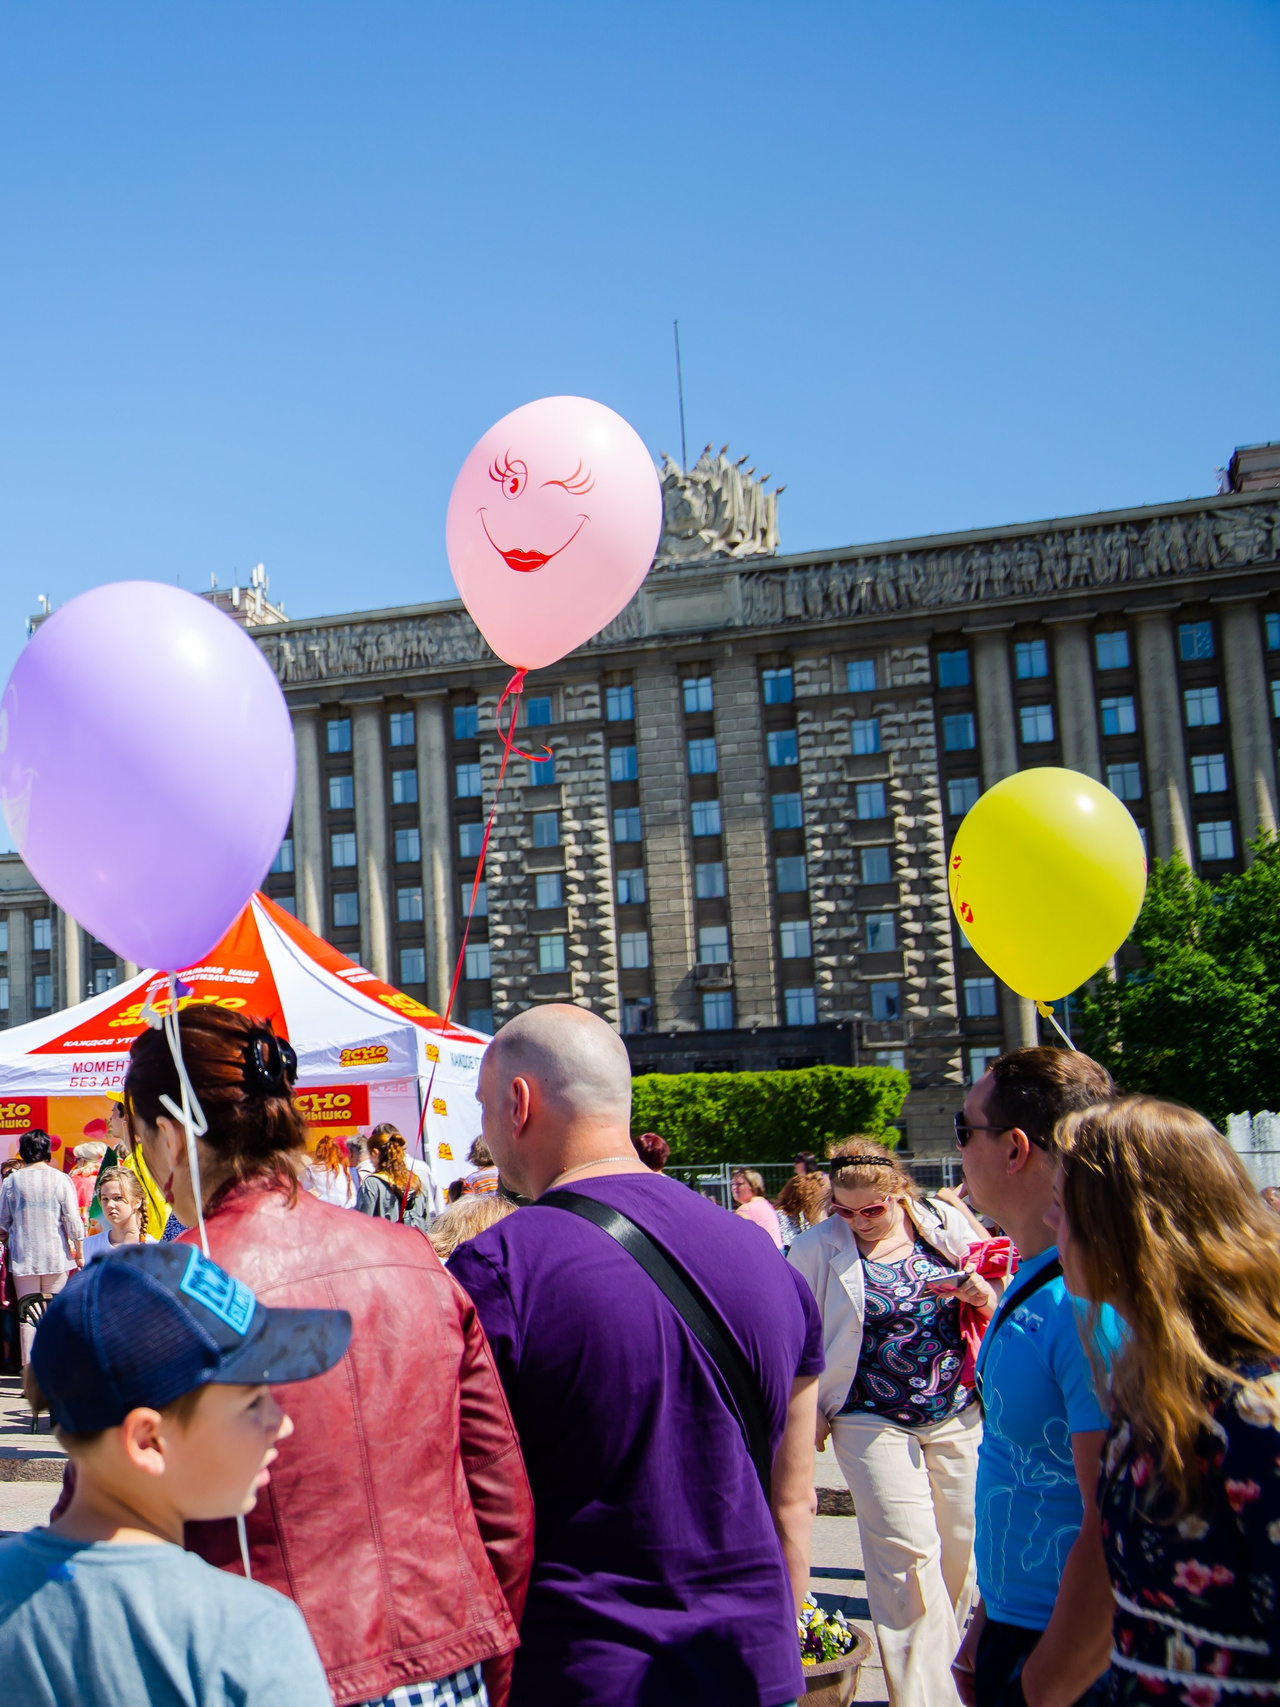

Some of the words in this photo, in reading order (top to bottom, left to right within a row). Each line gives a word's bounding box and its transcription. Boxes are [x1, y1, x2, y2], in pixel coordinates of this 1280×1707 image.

[228, 968, 260, 978] КАША
[62, 1038, 115, 1048] КАЖДОЕ
[339, 1045, 389, 1061] ЯСНО
[72, 1060, 134, 1073] МОМЕНТ
[69, 1076, 97, 1088] БЕЗ
[293, 1093, 352, 1112] СНО
[302, 1109, 352, 1121] НЫШКО
